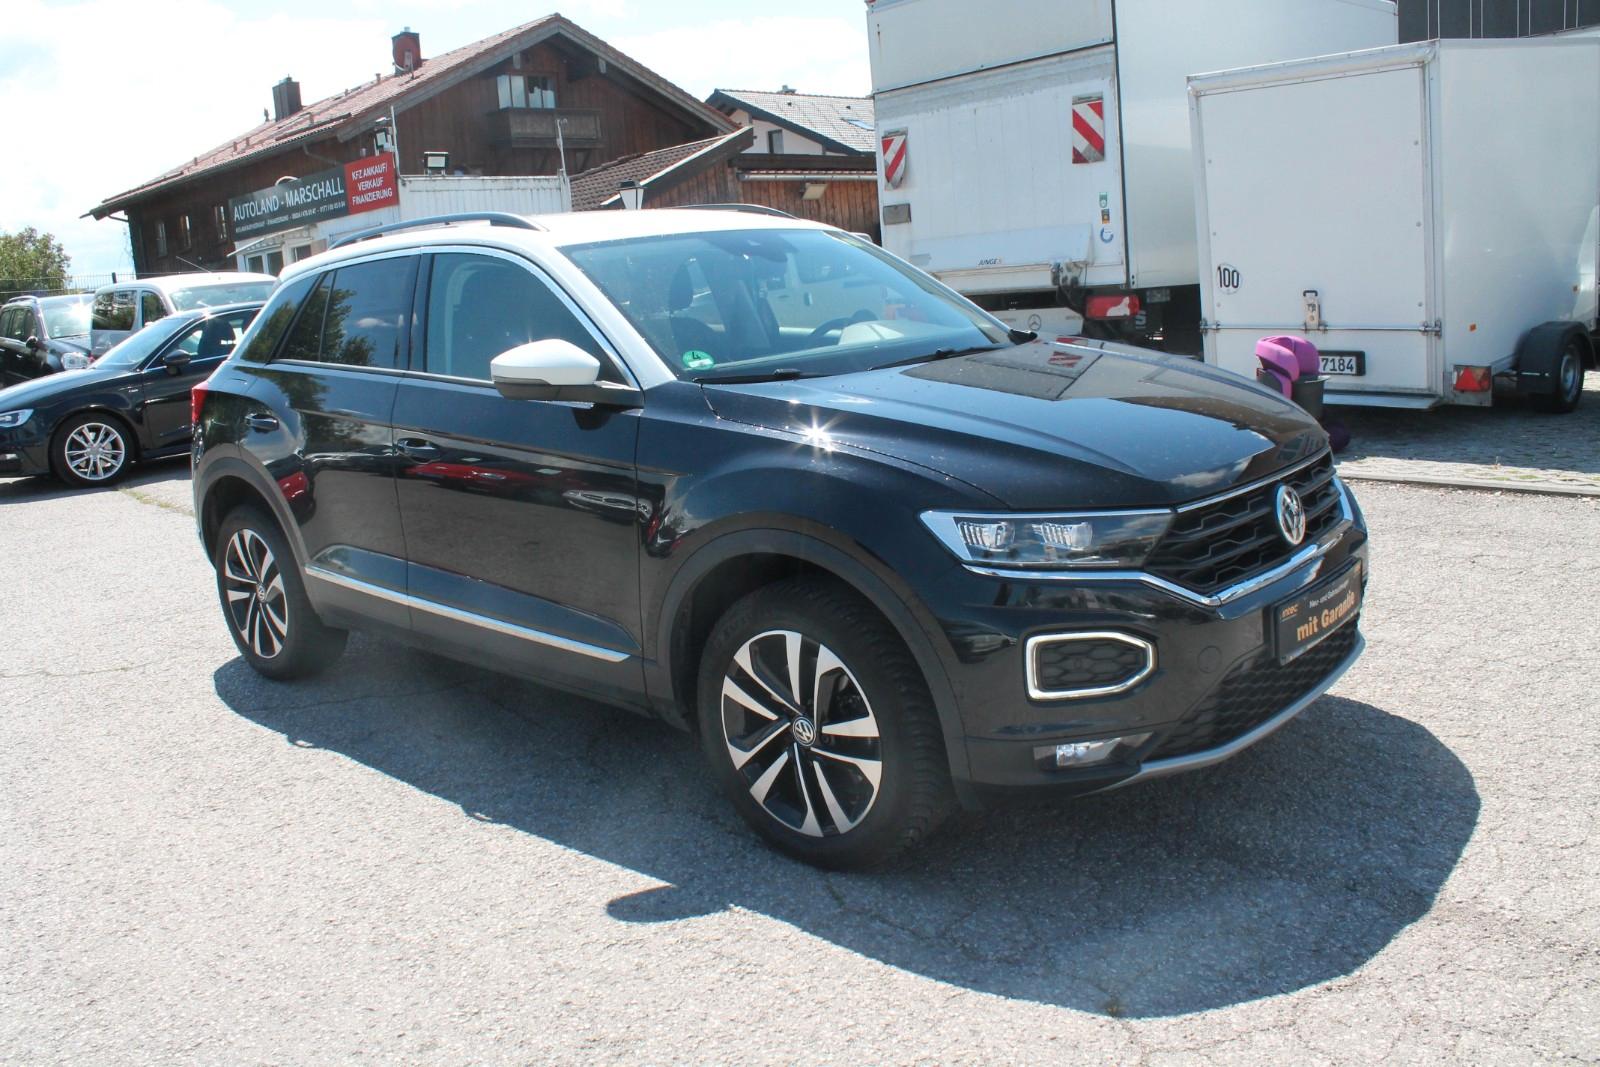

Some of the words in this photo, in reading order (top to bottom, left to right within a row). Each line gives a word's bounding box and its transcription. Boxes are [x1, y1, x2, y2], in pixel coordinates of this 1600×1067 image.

[357, 176, 384, 191] VERKAUF
[234, 195, 279, 221] AUTOLAND
[285, 177, 344, 207] MARSCHALL
[352, 187, 392, 204] FINANZIERUNG
[1217, 265, 1240, 289] 100
[1321, 357, 1355, 372] 7184
[1296, 615, 1318, 641] mit
